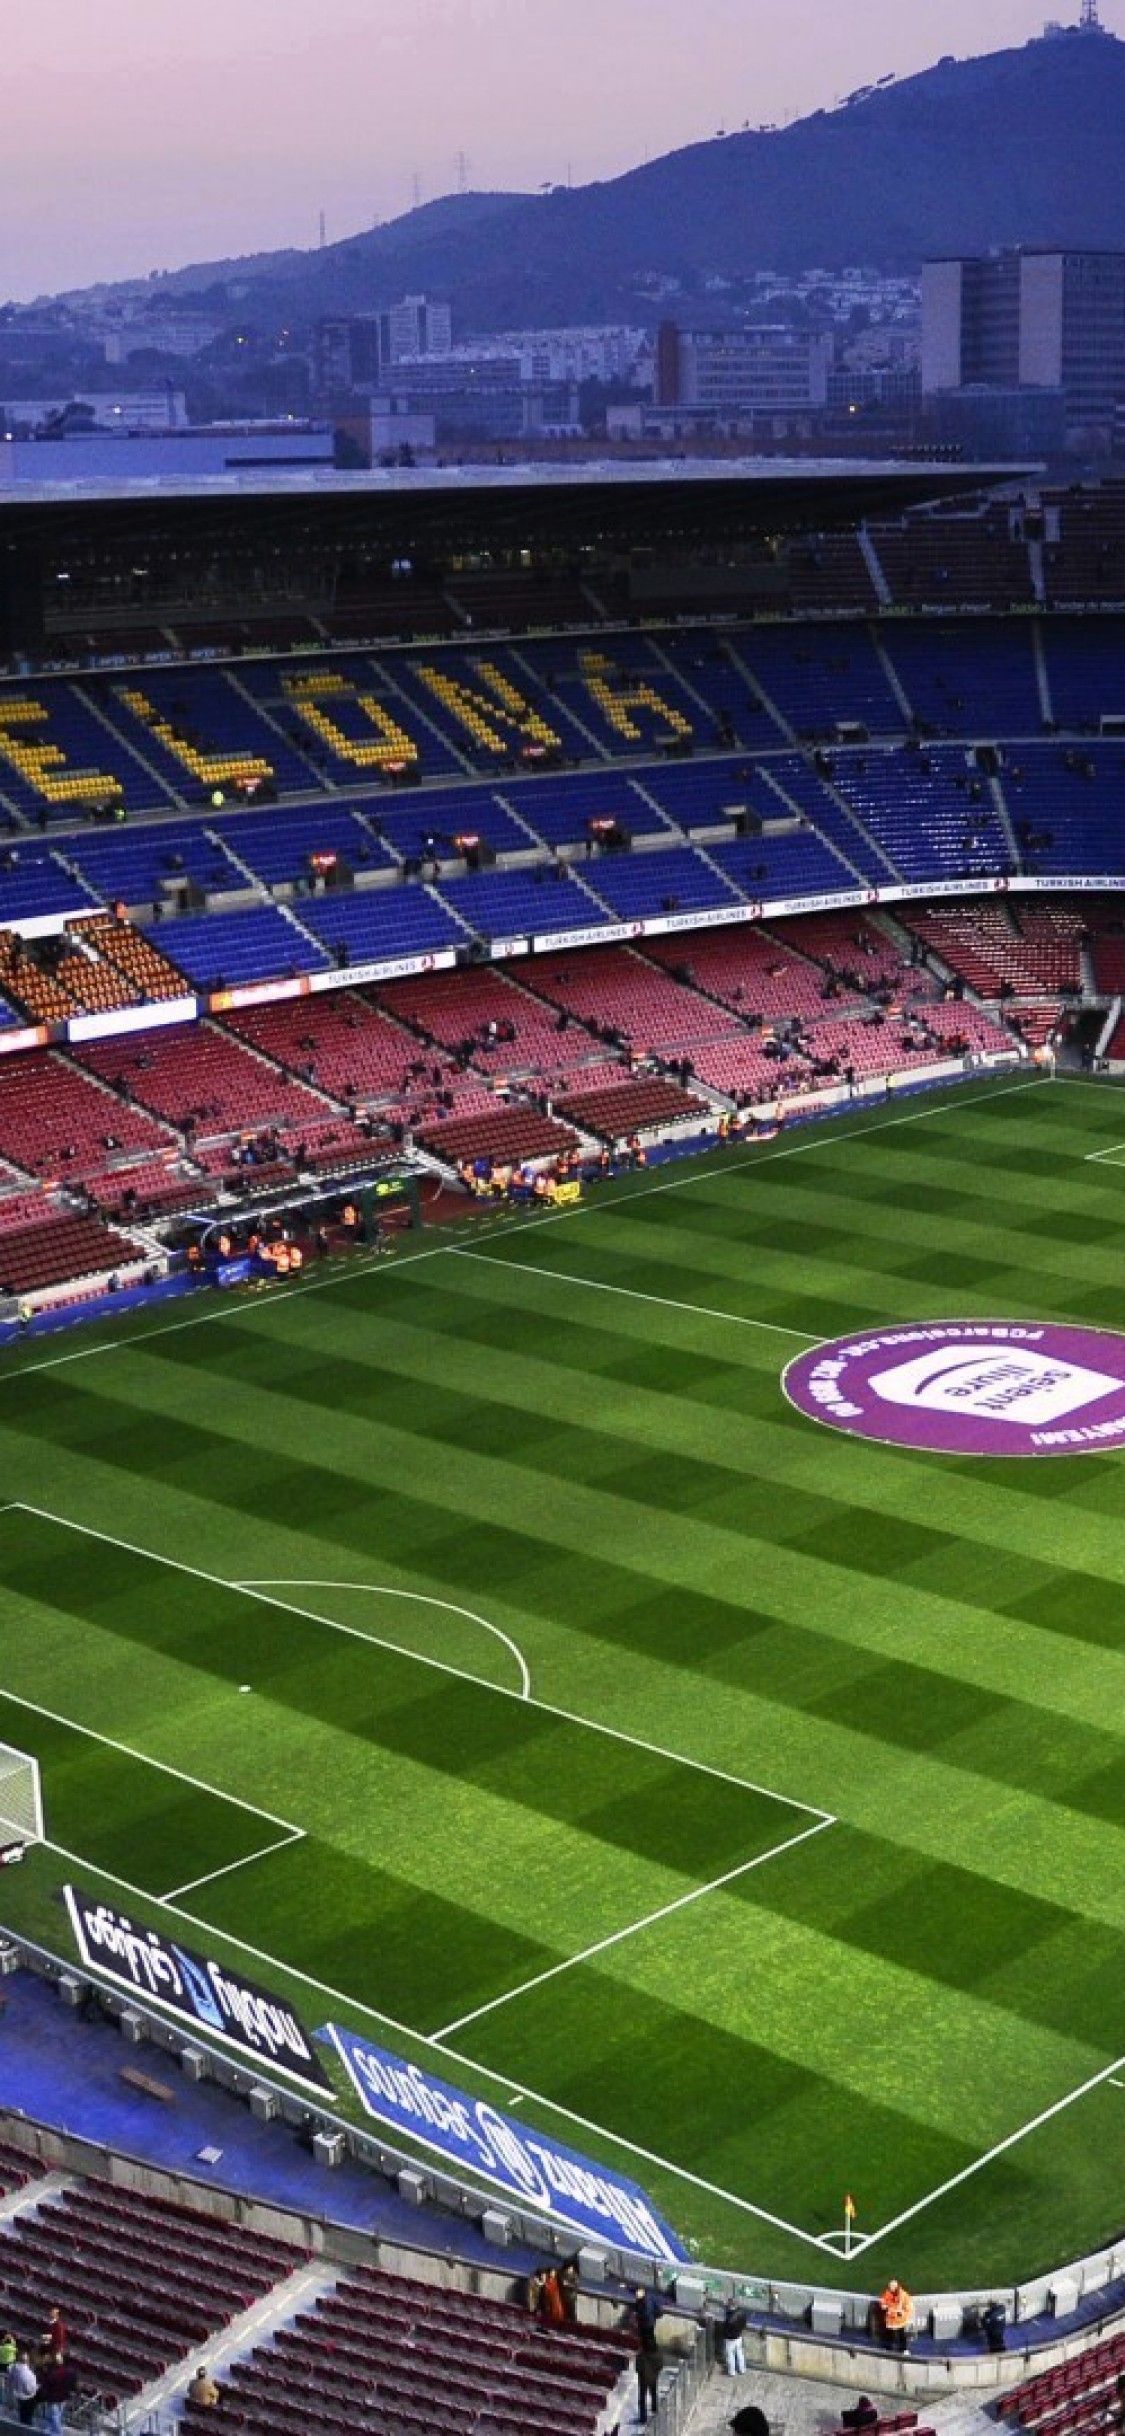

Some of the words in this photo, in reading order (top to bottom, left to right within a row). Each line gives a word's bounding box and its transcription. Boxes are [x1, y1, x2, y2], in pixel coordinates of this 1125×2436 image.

[902, 885, 940, 896] TURKISH
[944, 881, 988, 892] AIRLINES
[1035, 879, 1082, 887] TURKISH
[666, 915, 704, 928] TURKISH
[545, 933, 585, 947] TURKISH
[585, 926, 627, 941] AIRLINES
[328, 969, 369, 984] TURKISH
[206, 1960, 312, 2061] mobily
[352, 2047, 497, 2168] Seguros
[524, 2139, 672, 2262] Allianz
